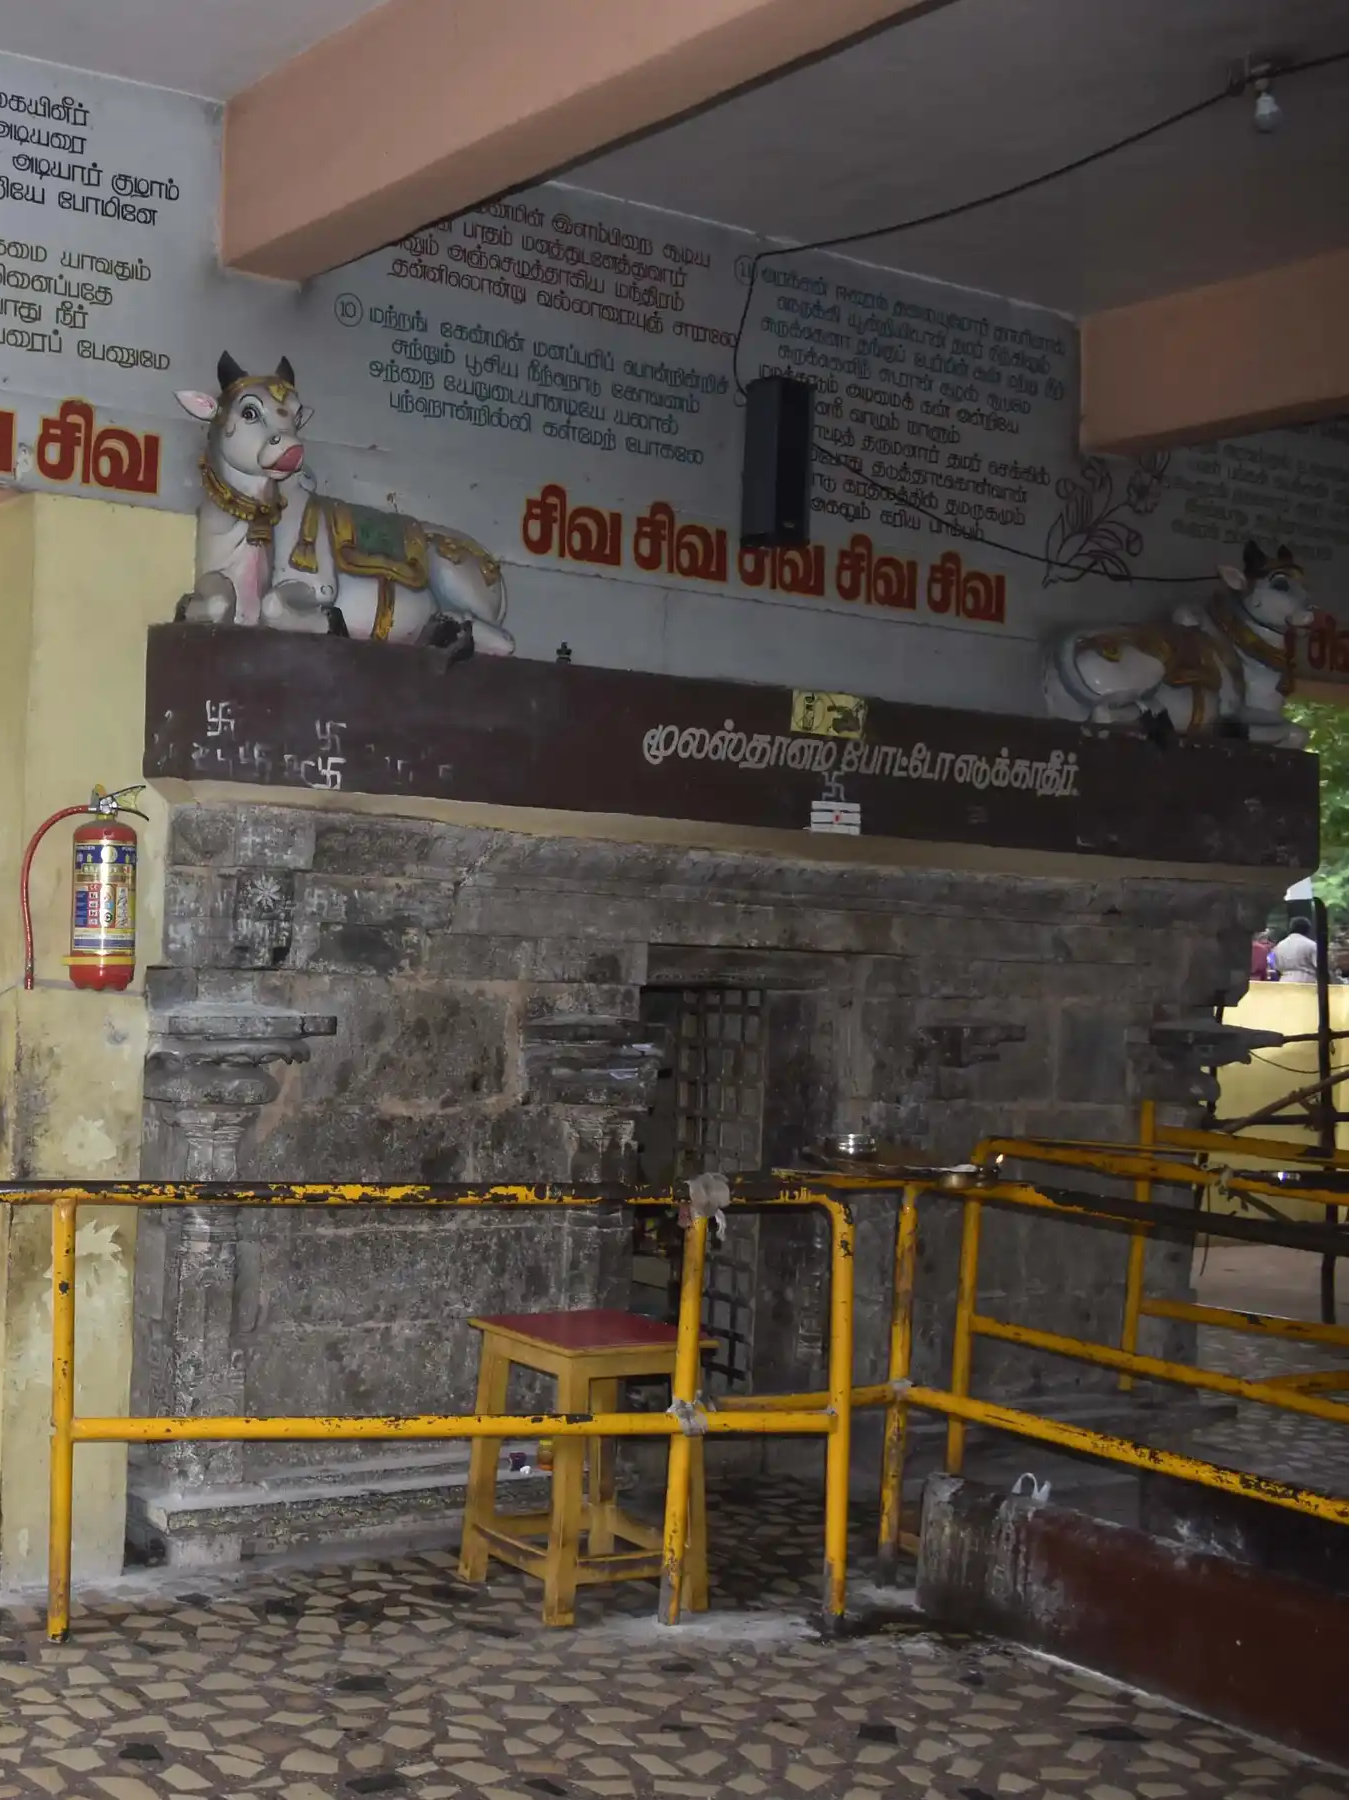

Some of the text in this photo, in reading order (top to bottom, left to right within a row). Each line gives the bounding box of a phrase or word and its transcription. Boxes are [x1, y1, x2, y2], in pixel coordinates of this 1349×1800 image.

[35, 399, 161, 496] சிவ
[522, 483, 622, 566] சிவ
[634, 501, 728, 582] சிவ
[835, 533, 918, 611] சிவ
[926, 551, 1007, 624] சிவ
